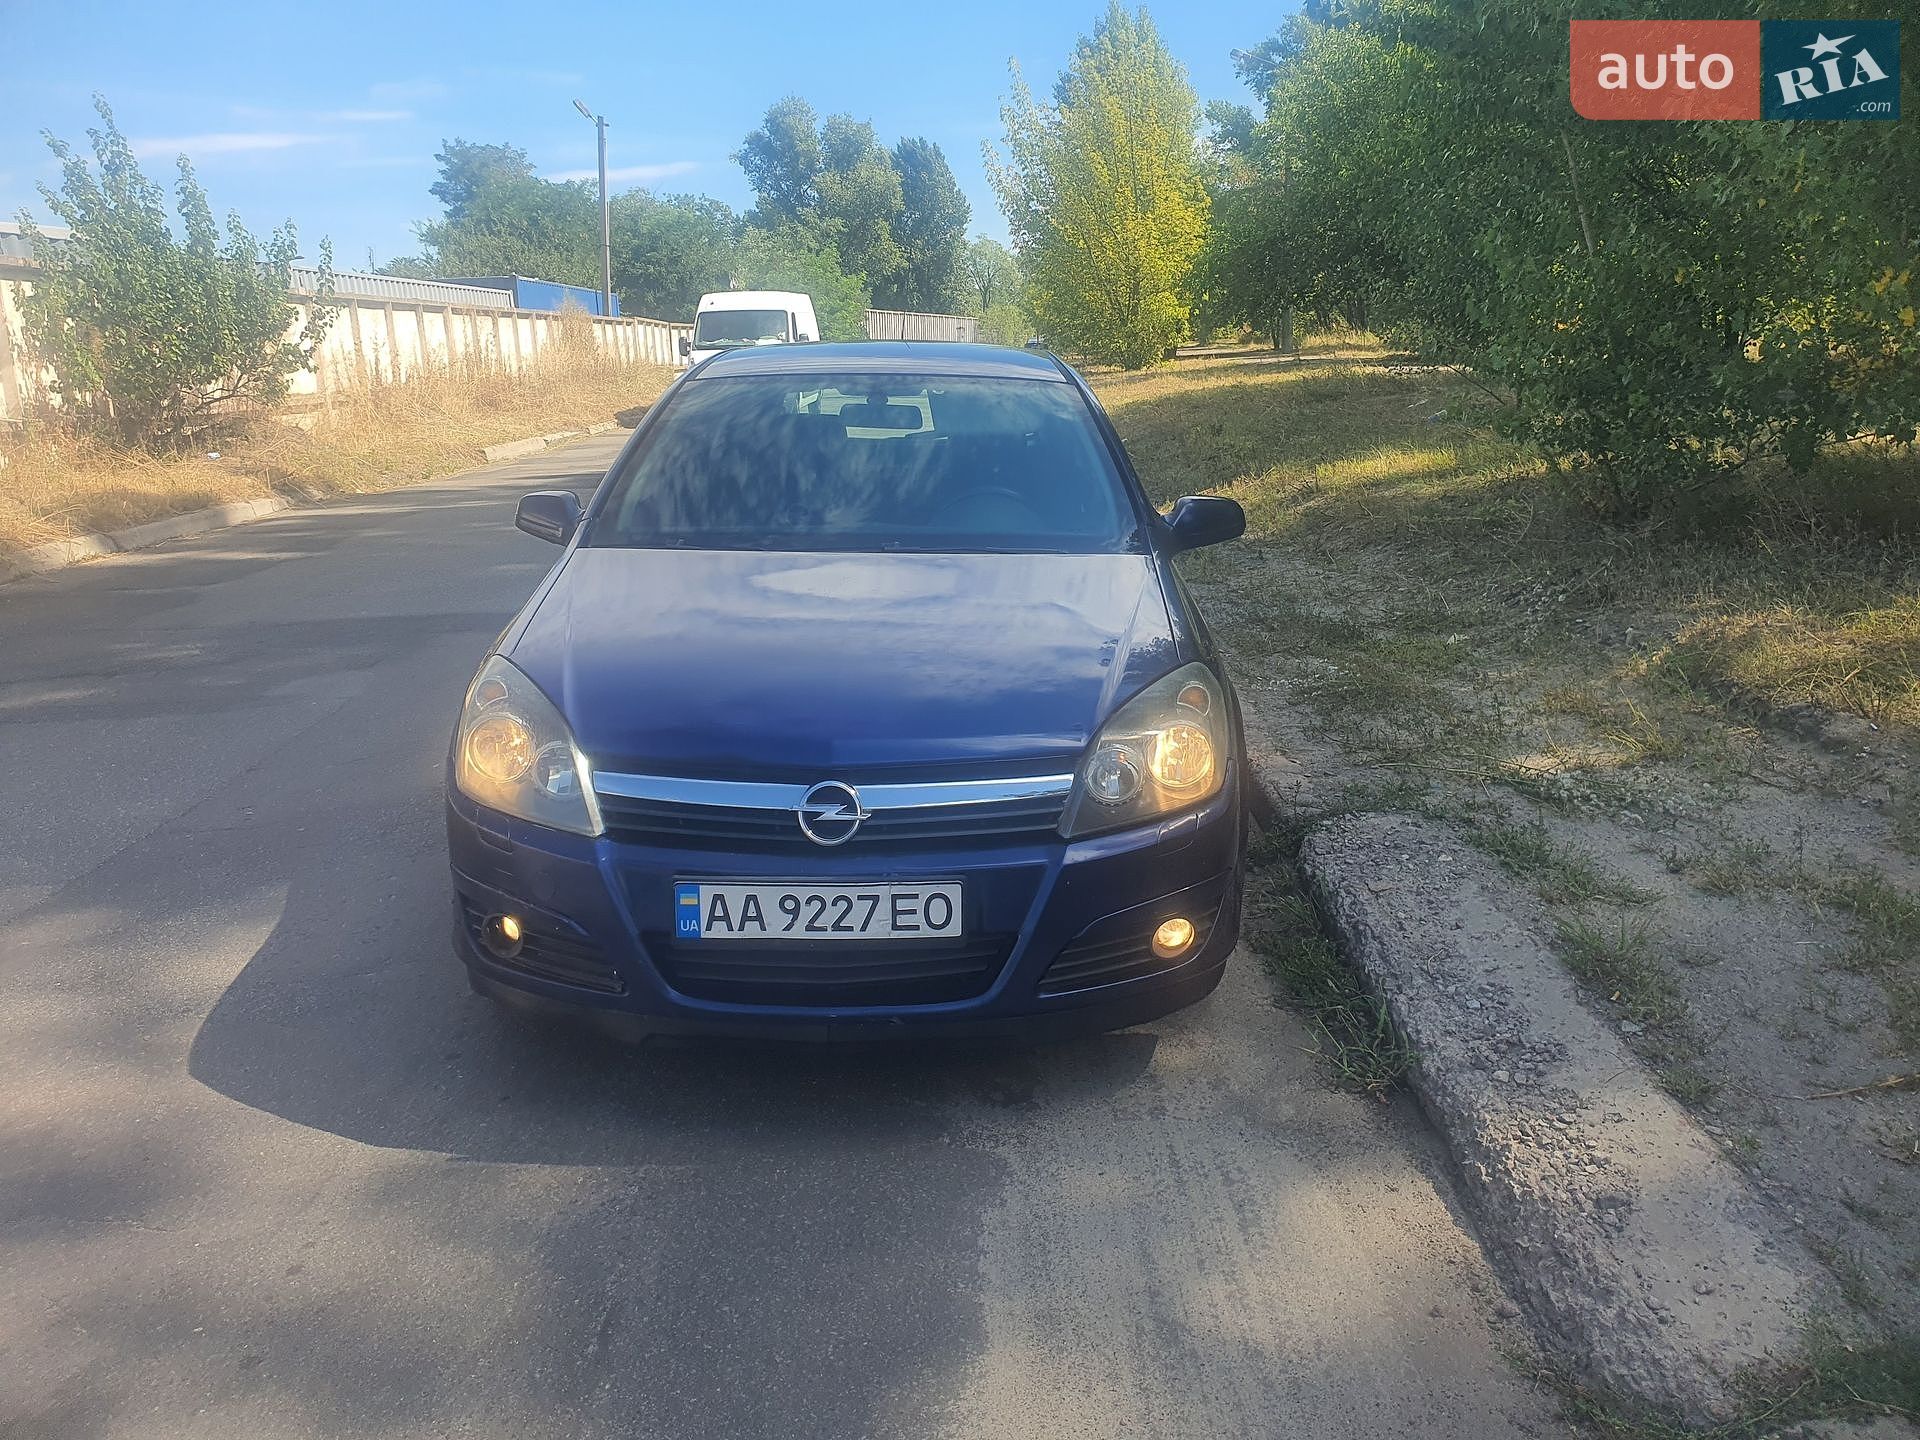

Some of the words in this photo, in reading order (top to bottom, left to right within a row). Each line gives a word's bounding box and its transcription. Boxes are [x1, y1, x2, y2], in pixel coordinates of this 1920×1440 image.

[705, 893, 767, 932] AA
[778, 893, 880, 932] 9227
[890, 892, 953, 931] EO
[680, 920, 699, 931] UA
